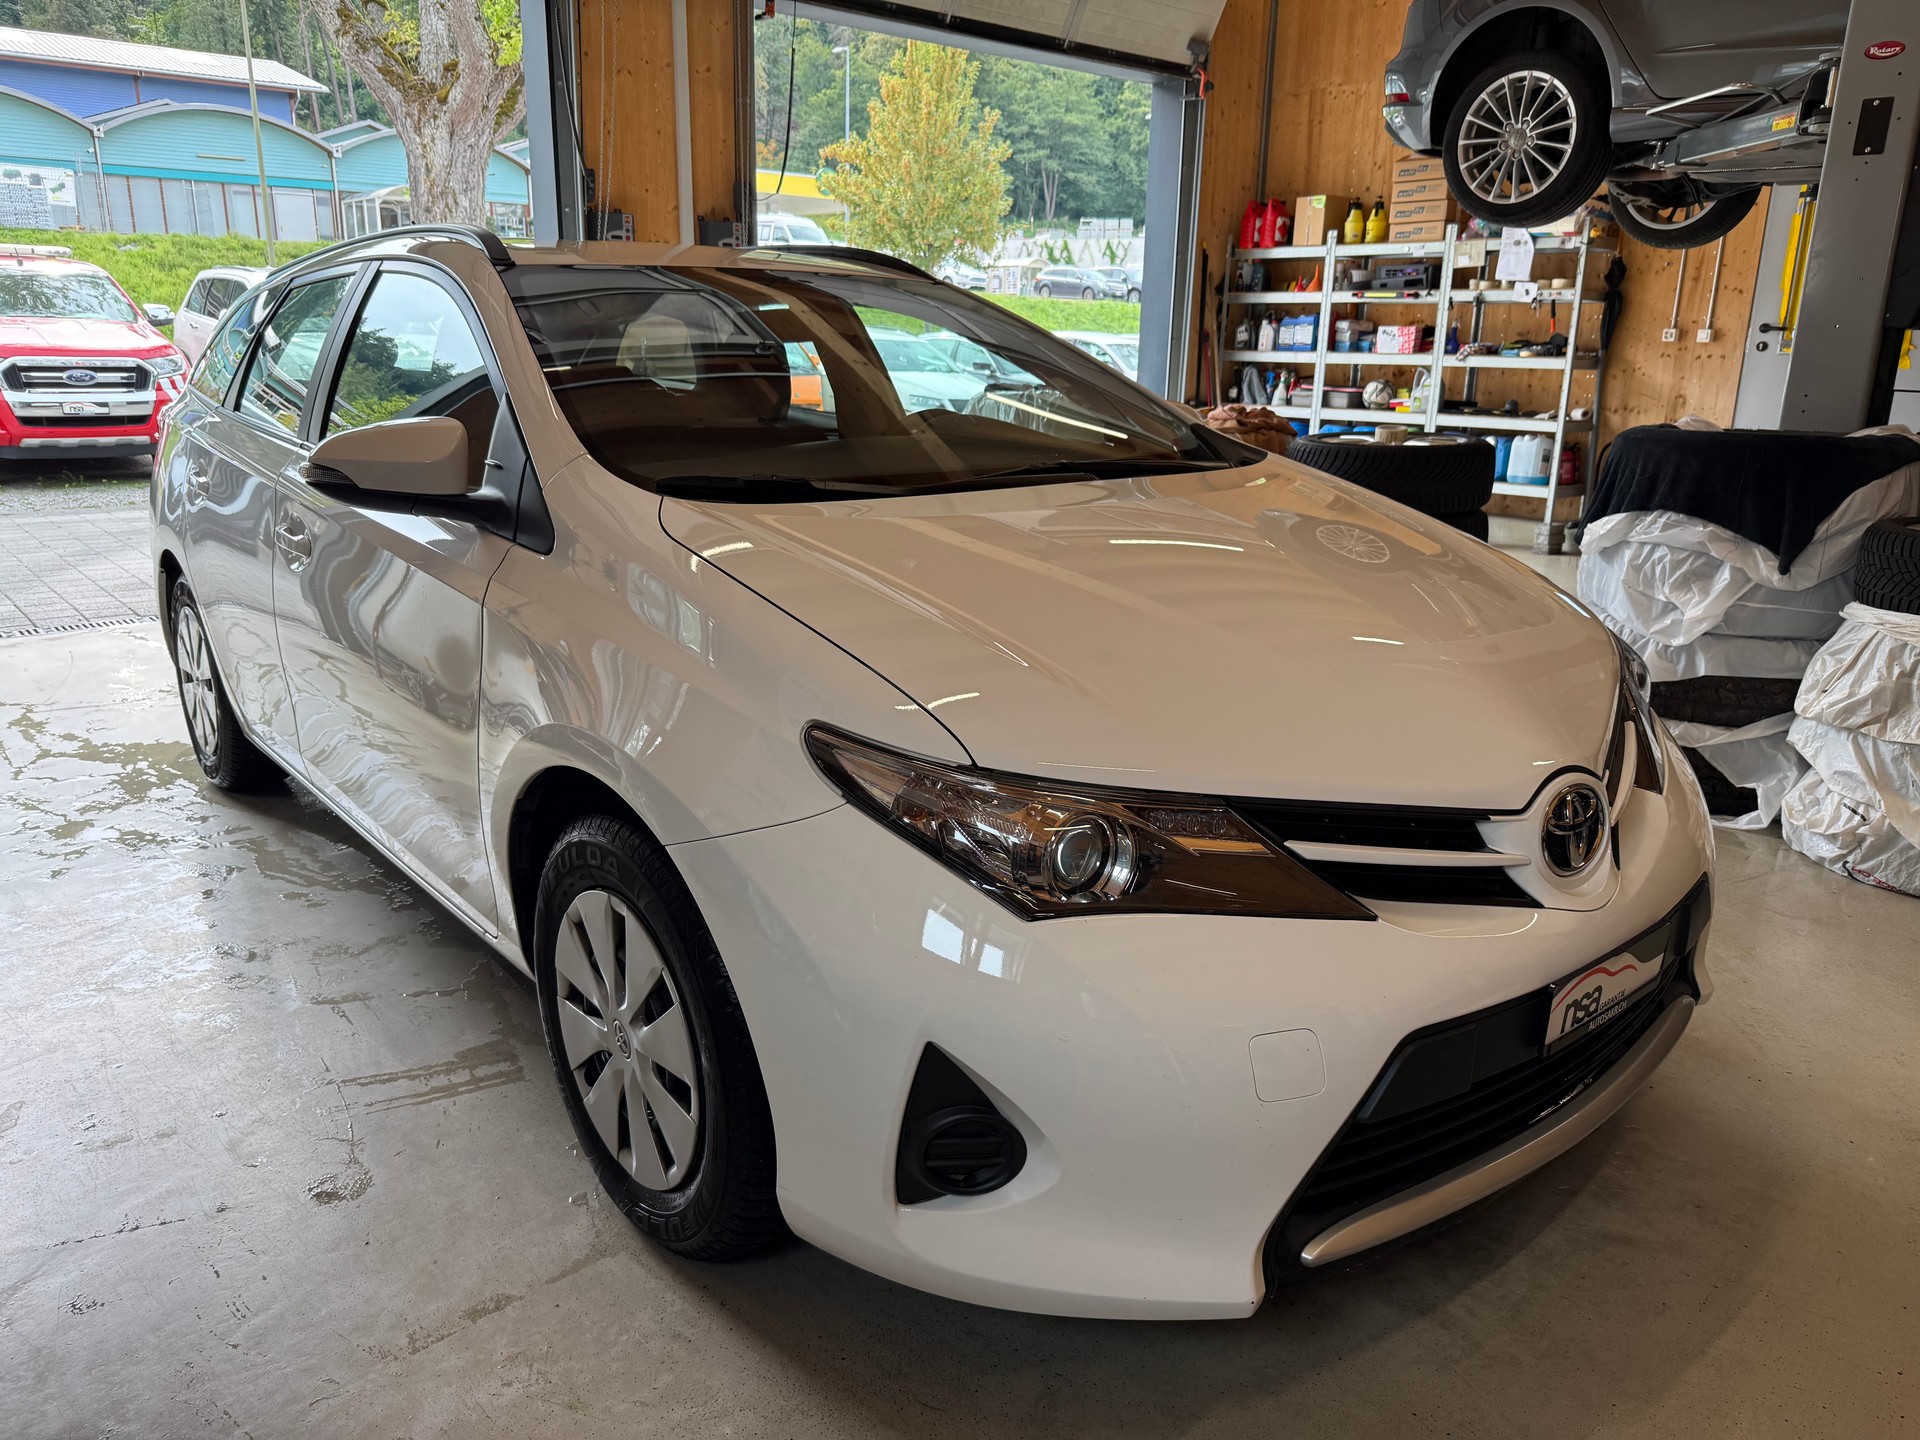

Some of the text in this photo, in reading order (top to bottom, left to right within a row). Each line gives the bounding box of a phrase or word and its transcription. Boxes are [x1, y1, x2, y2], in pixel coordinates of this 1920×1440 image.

[1869, 46, 1902, 55] Rotary
[548, 844, 620, 886] FULDA
[1560, 985, 1602, 1034] nsa
